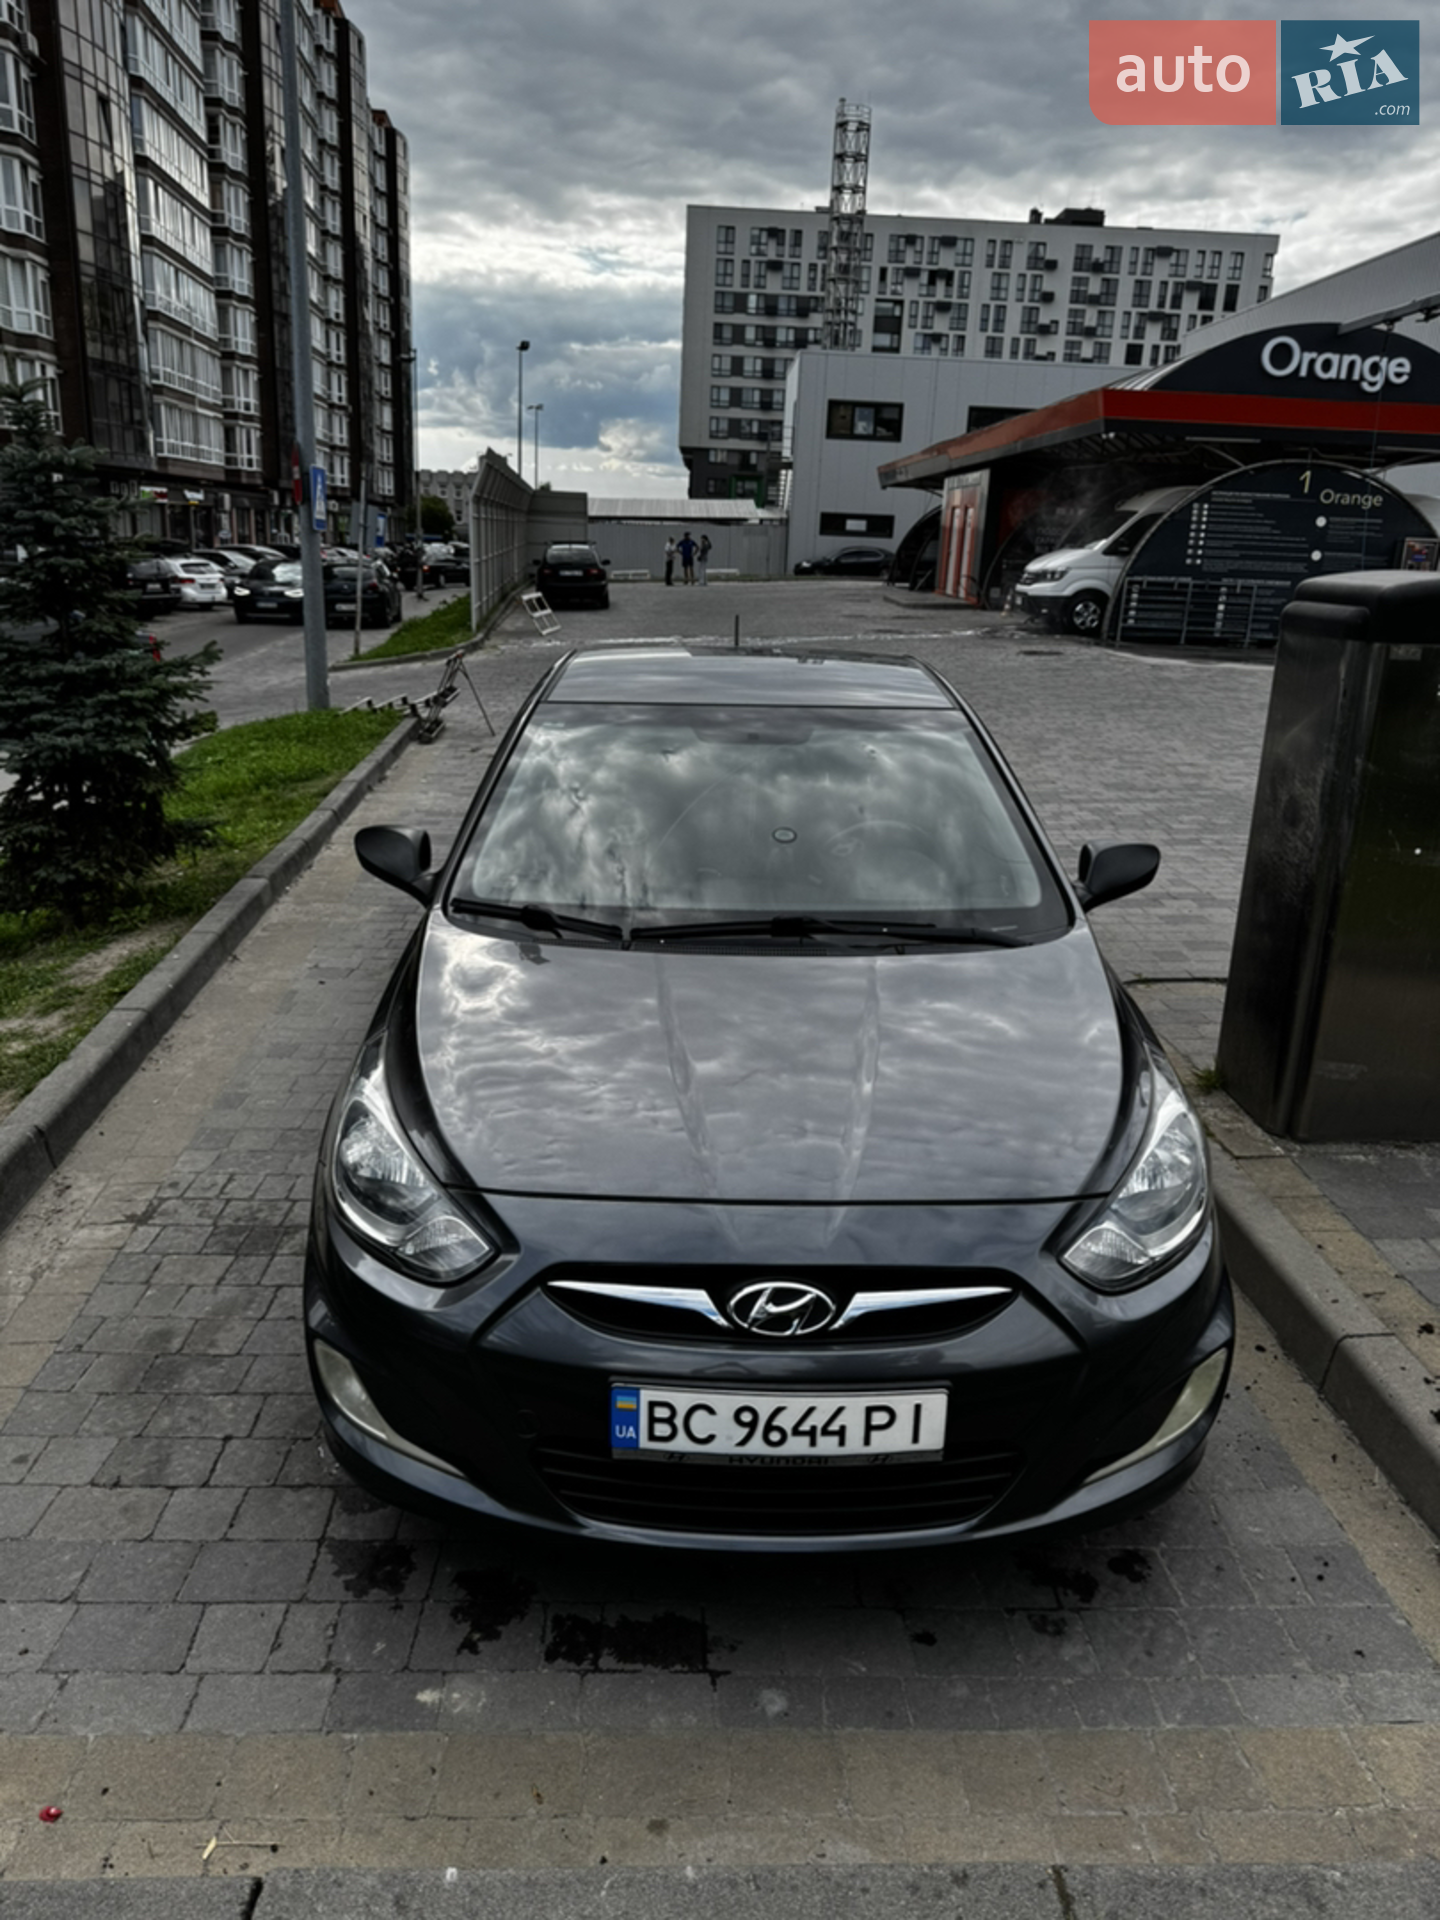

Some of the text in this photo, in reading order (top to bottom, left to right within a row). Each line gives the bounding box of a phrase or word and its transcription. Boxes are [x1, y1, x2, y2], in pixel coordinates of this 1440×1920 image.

[1261, 335, 1412, 393] Orange
[1298, 469, 1312, 494] 1
[1319, 488, 1384, 510] Orange
[615, 1424, 637, 1439] UA
[647, 1400, 718, 1446] BC
[732, 1404, 847, 1448] 9644
